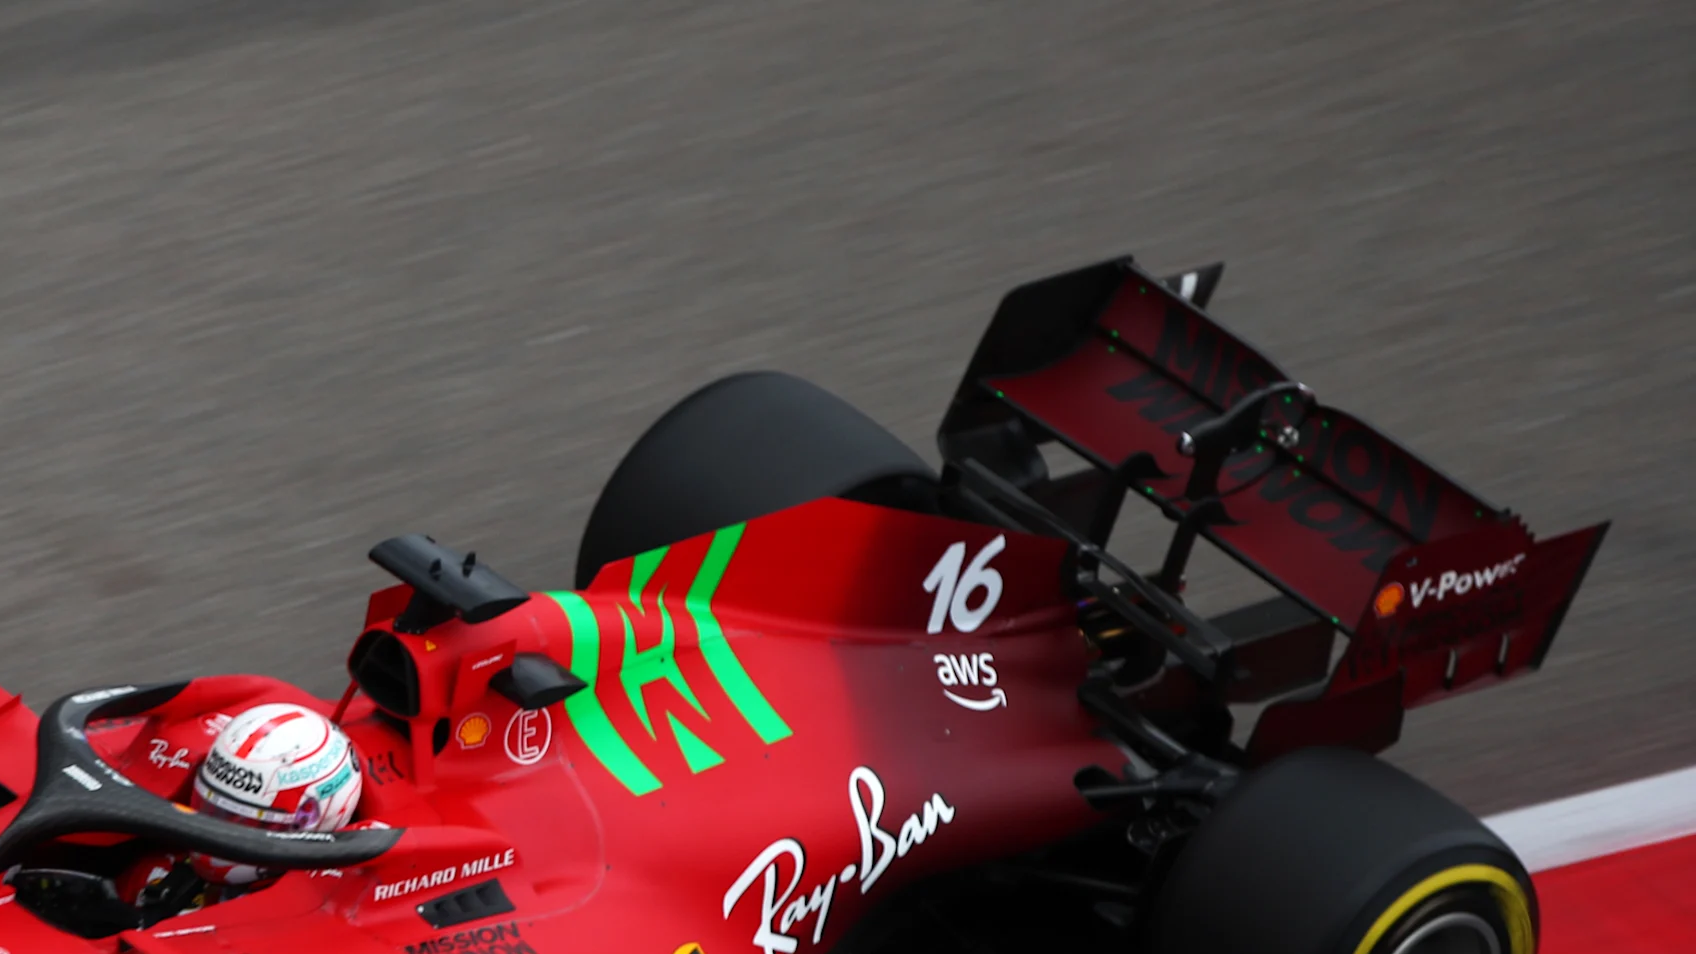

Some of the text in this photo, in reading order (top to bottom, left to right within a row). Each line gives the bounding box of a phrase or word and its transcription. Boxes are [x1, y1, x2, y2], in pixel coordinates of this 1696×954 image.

[1152, 307, 1440, 539] MISION
[923, 535, 1006, 635] 16
[934, 652, 998, 687] aws
[374, 848, 515, 901] RICHARD MILLE
